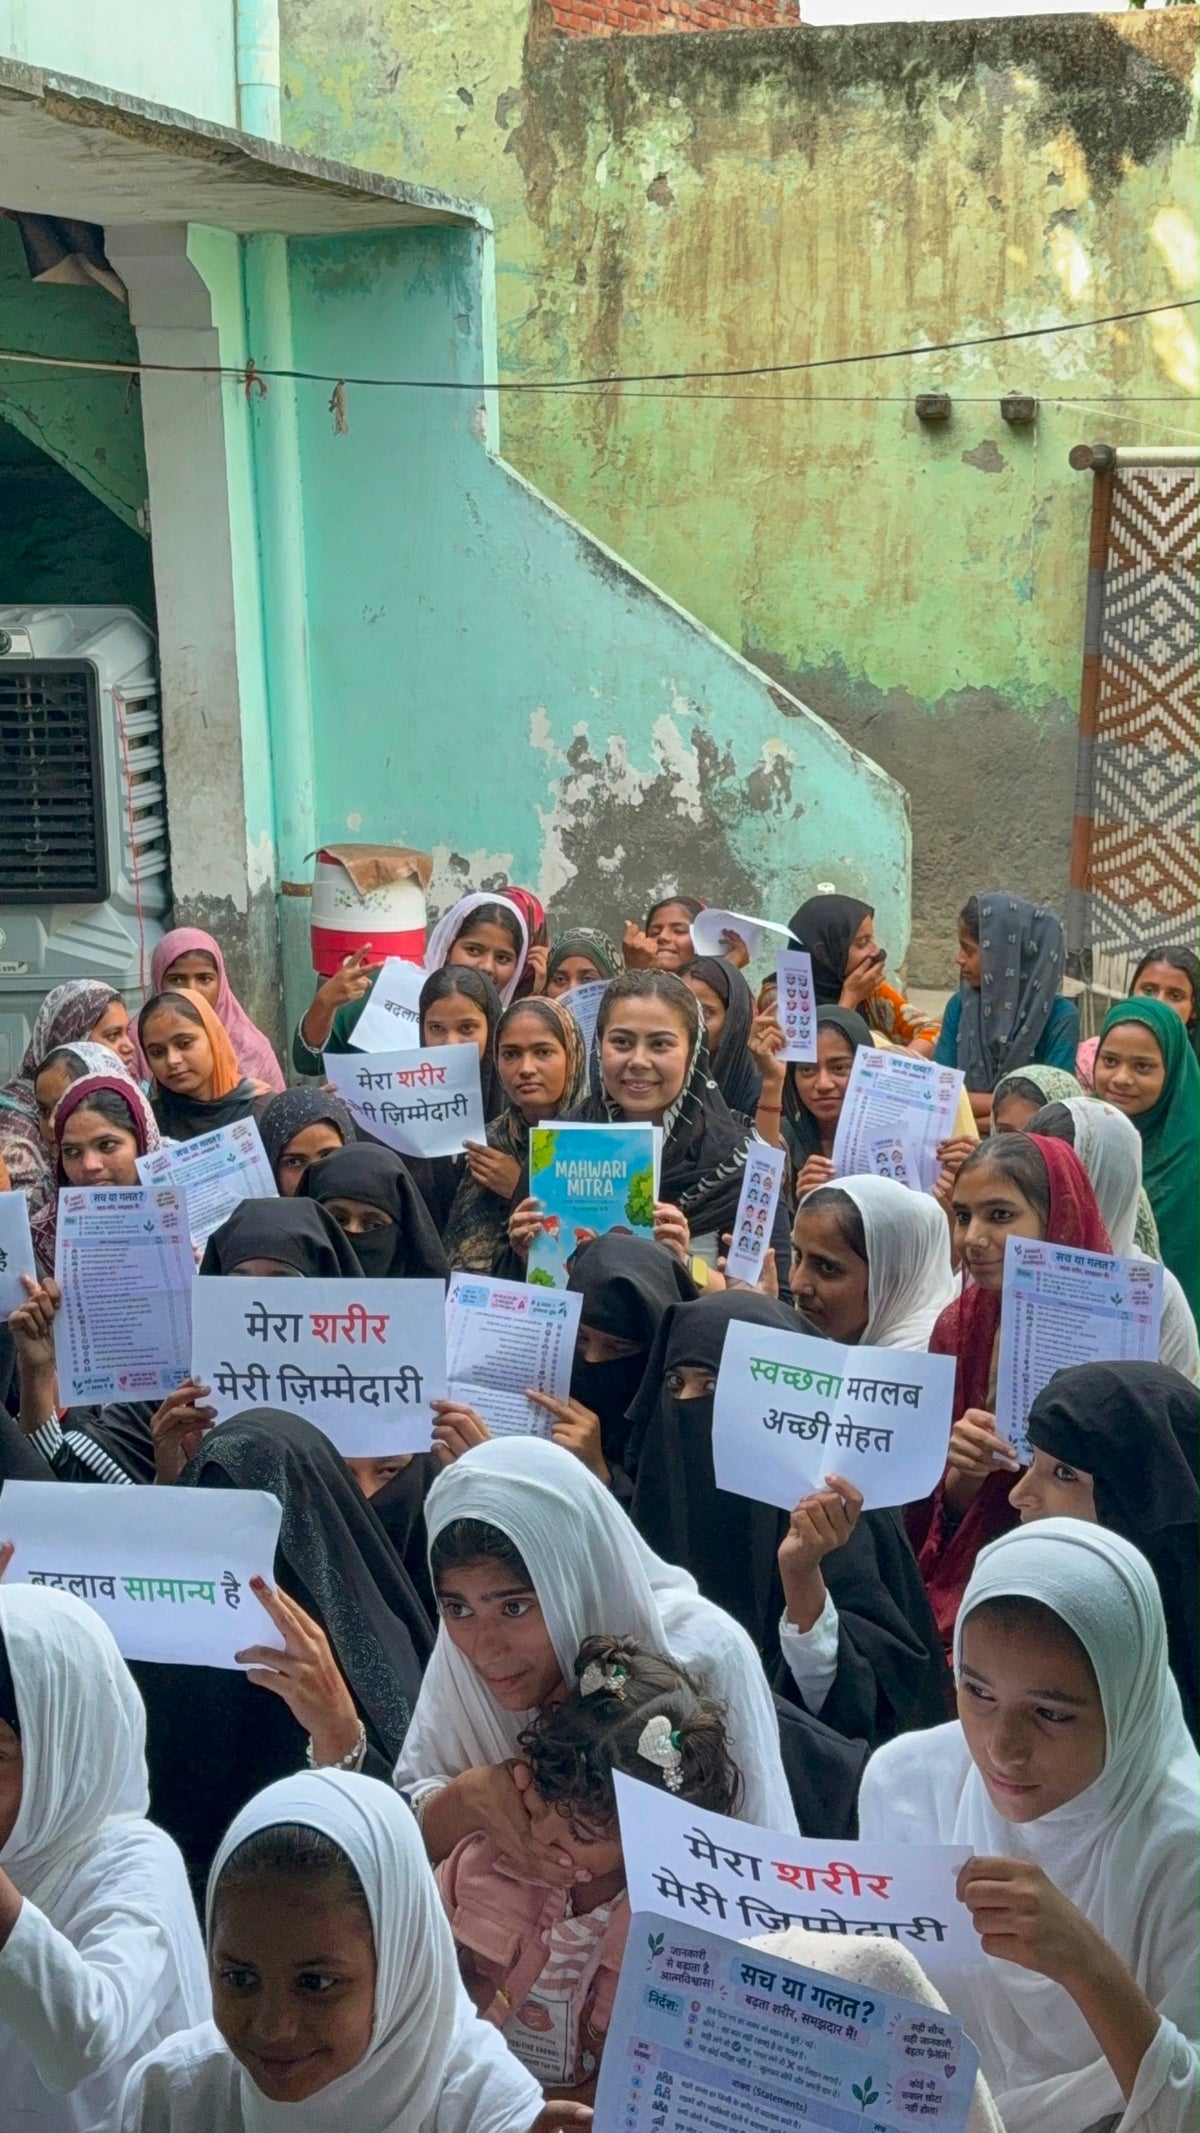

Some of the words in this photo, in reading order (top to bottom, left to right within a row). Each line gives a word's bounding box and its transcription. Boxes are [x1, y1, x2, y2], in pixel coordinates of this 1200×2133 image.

[356, 1067, 392, 1091] मेरा
[396, 1062, 447, 1088] शरीर
[555, 1159, 627, 1179] MAHWARI
[567, 1178, 614, 1197] MITRA
[244, 1301, 303, 1343] मेरा
[309, 1302, 390, 1345] शरीर
[213, 1361, 270, 1401] मेरी
[749, 1356, 845, 1400] स्वच्छता
[847, 1377, 923, 1409] मतलब
[762, 1407, 832, 1445] अच्छी
[834, 1414, 894, 1454] सेहत
[121, 1576, 216, 1606] सामान्य
[220, 1570, 241, 1610] है
[683, 1826, 762, 1882] मेरा
[771, 1861, 893, 1900] शरीर
[652, 1866, 728, 1920] मेरी
[740, 1963, 777, 1992] सच
[782, 1976, 807, 2002] या
[811, 1985, 875, 2024] गलत?
[801, 2012, 843, 2036] समझदार
[752, 2086, 808, 2114] (Statements)
